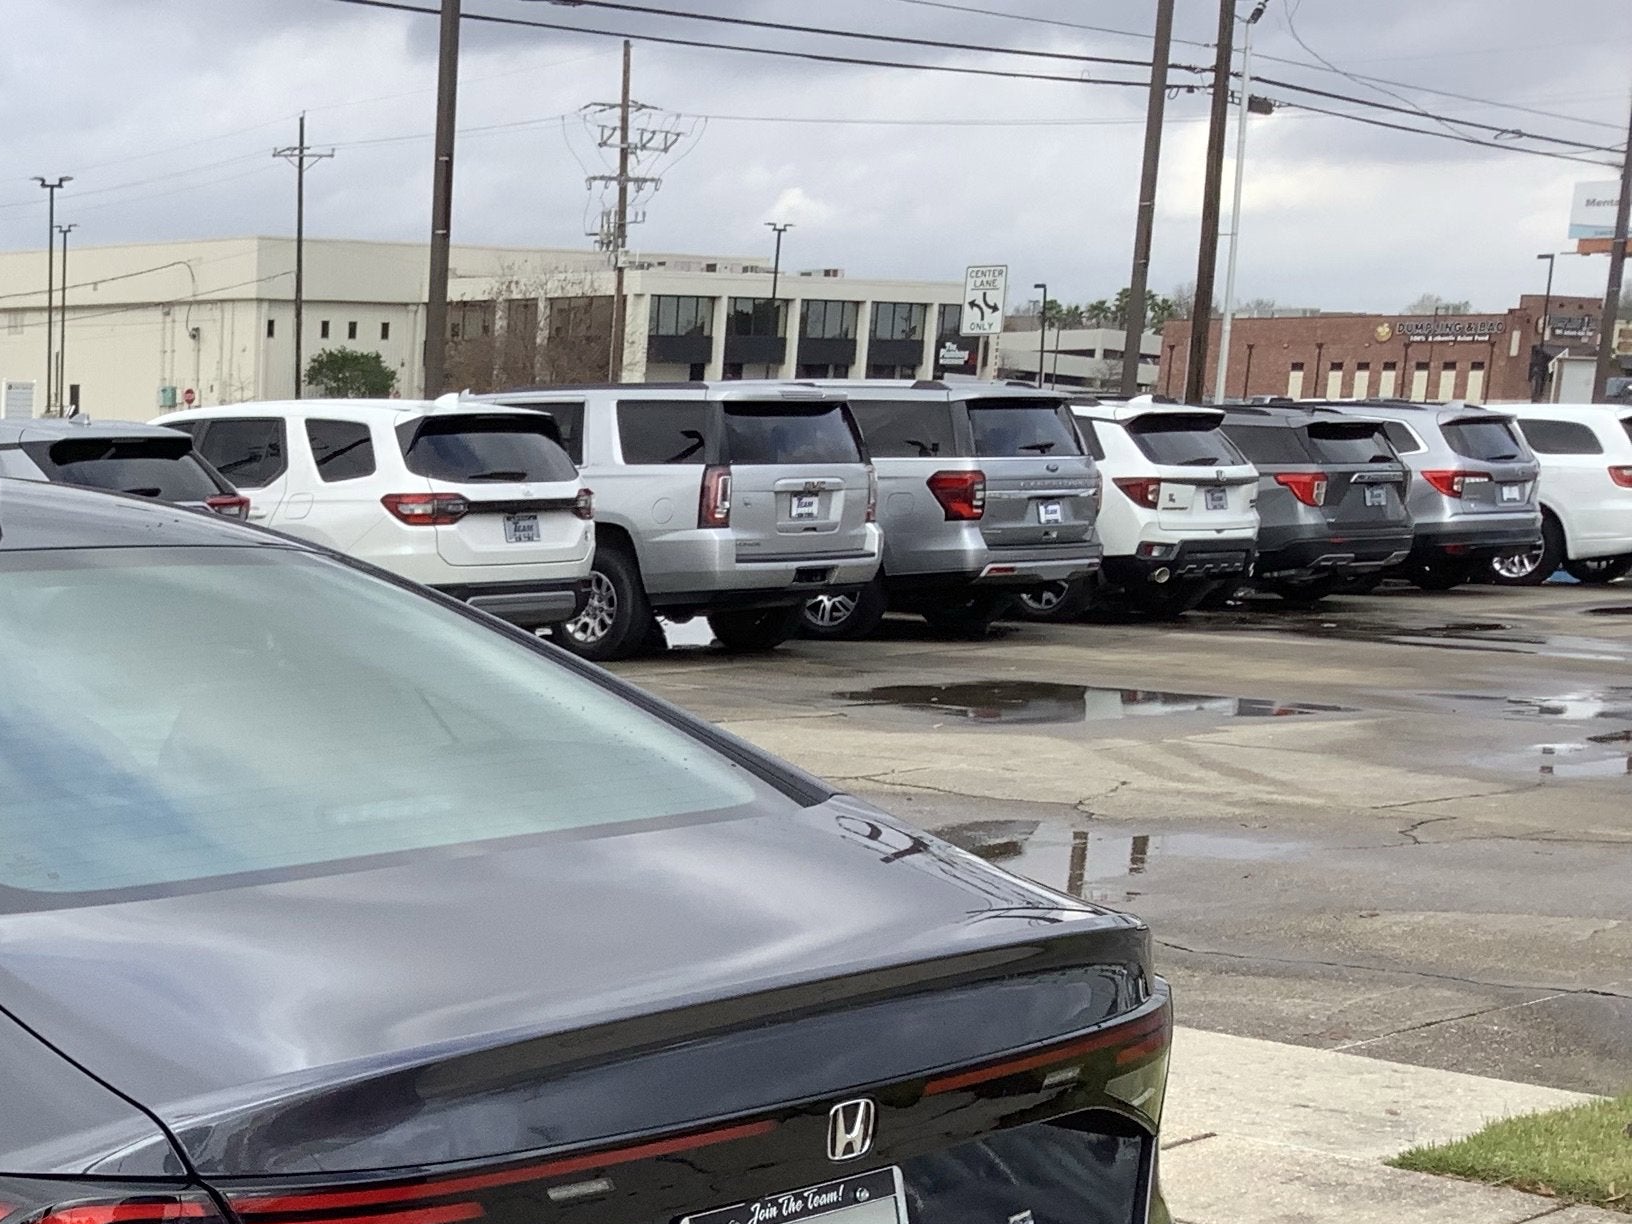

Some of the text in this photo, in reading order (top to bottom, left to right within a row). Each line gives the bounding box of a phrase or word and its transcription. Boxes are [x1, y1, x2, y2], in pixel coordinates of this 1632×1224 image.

[969, 269, 1004, 279] CENTER
[973, 279, 998, 288] LANE
[969, 322, 994, 331] ONLY
[777, 1192, 804, 1216] The
[804, 1185, 844, 1210] Team!
